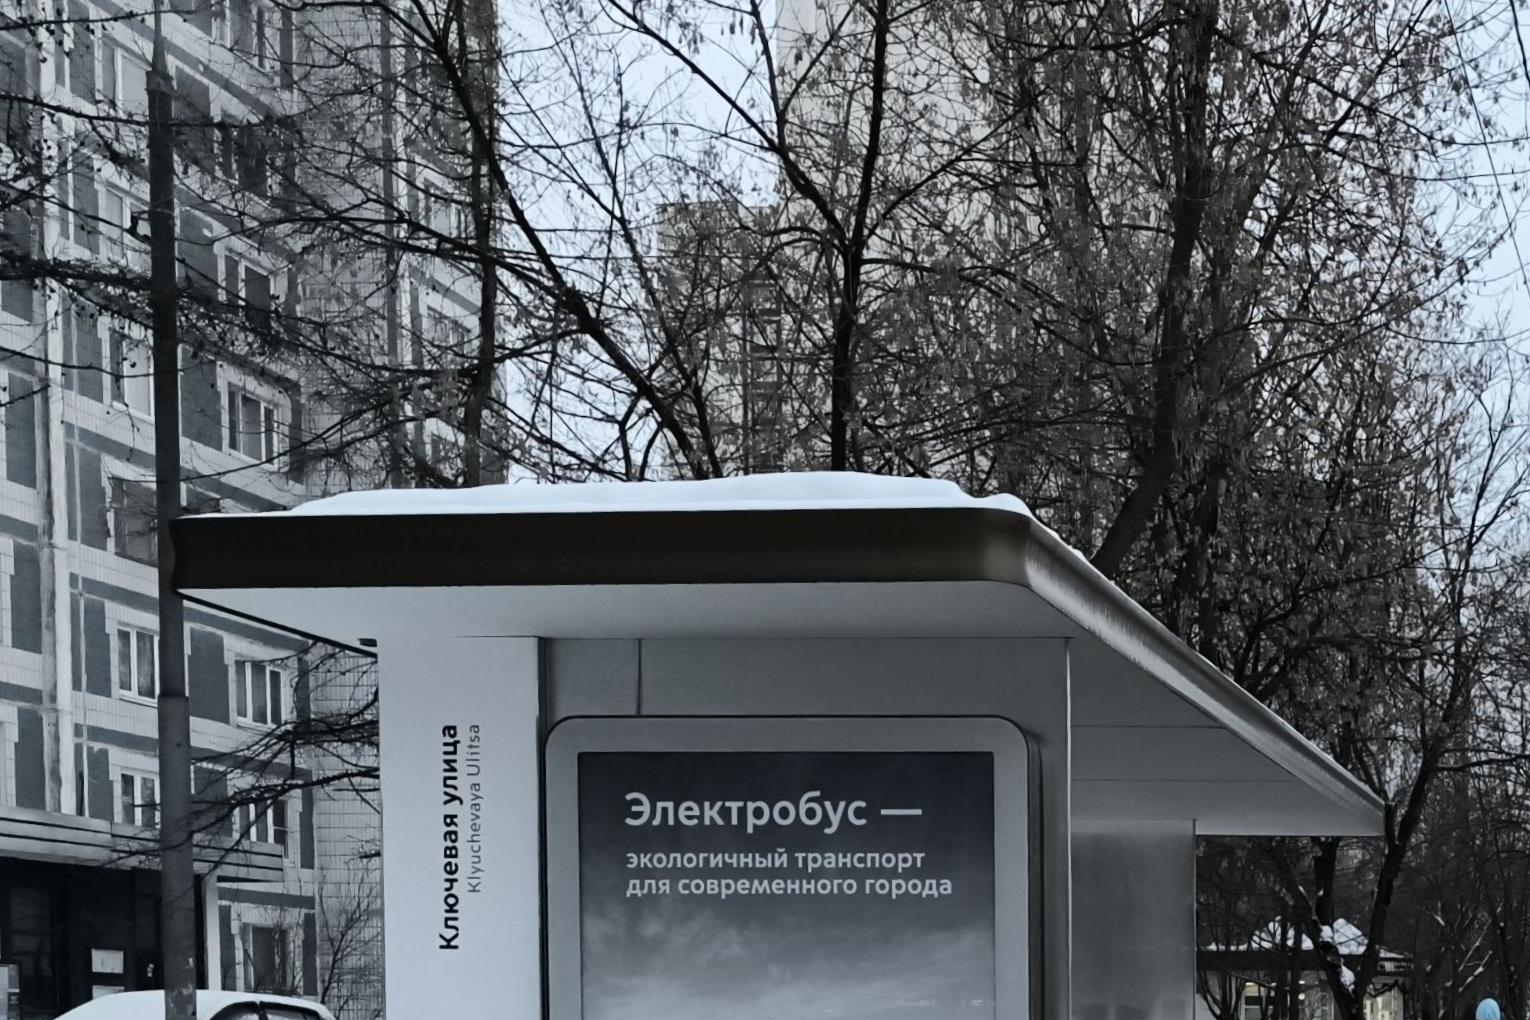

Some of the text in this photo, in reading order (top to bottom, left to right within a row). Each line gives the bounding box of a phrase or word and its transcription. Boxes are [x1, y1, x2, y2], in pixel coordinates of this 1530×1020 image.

[466, 724, 485, 894] Klyuchevaya Ulitsa
[624, 791, 868, 834] Электробус
[438, 724, 463, 951] Ключевая улица
[625, 846, 925, 872] экологичный транспорт
[625, 877, 953, 900] для современного города
